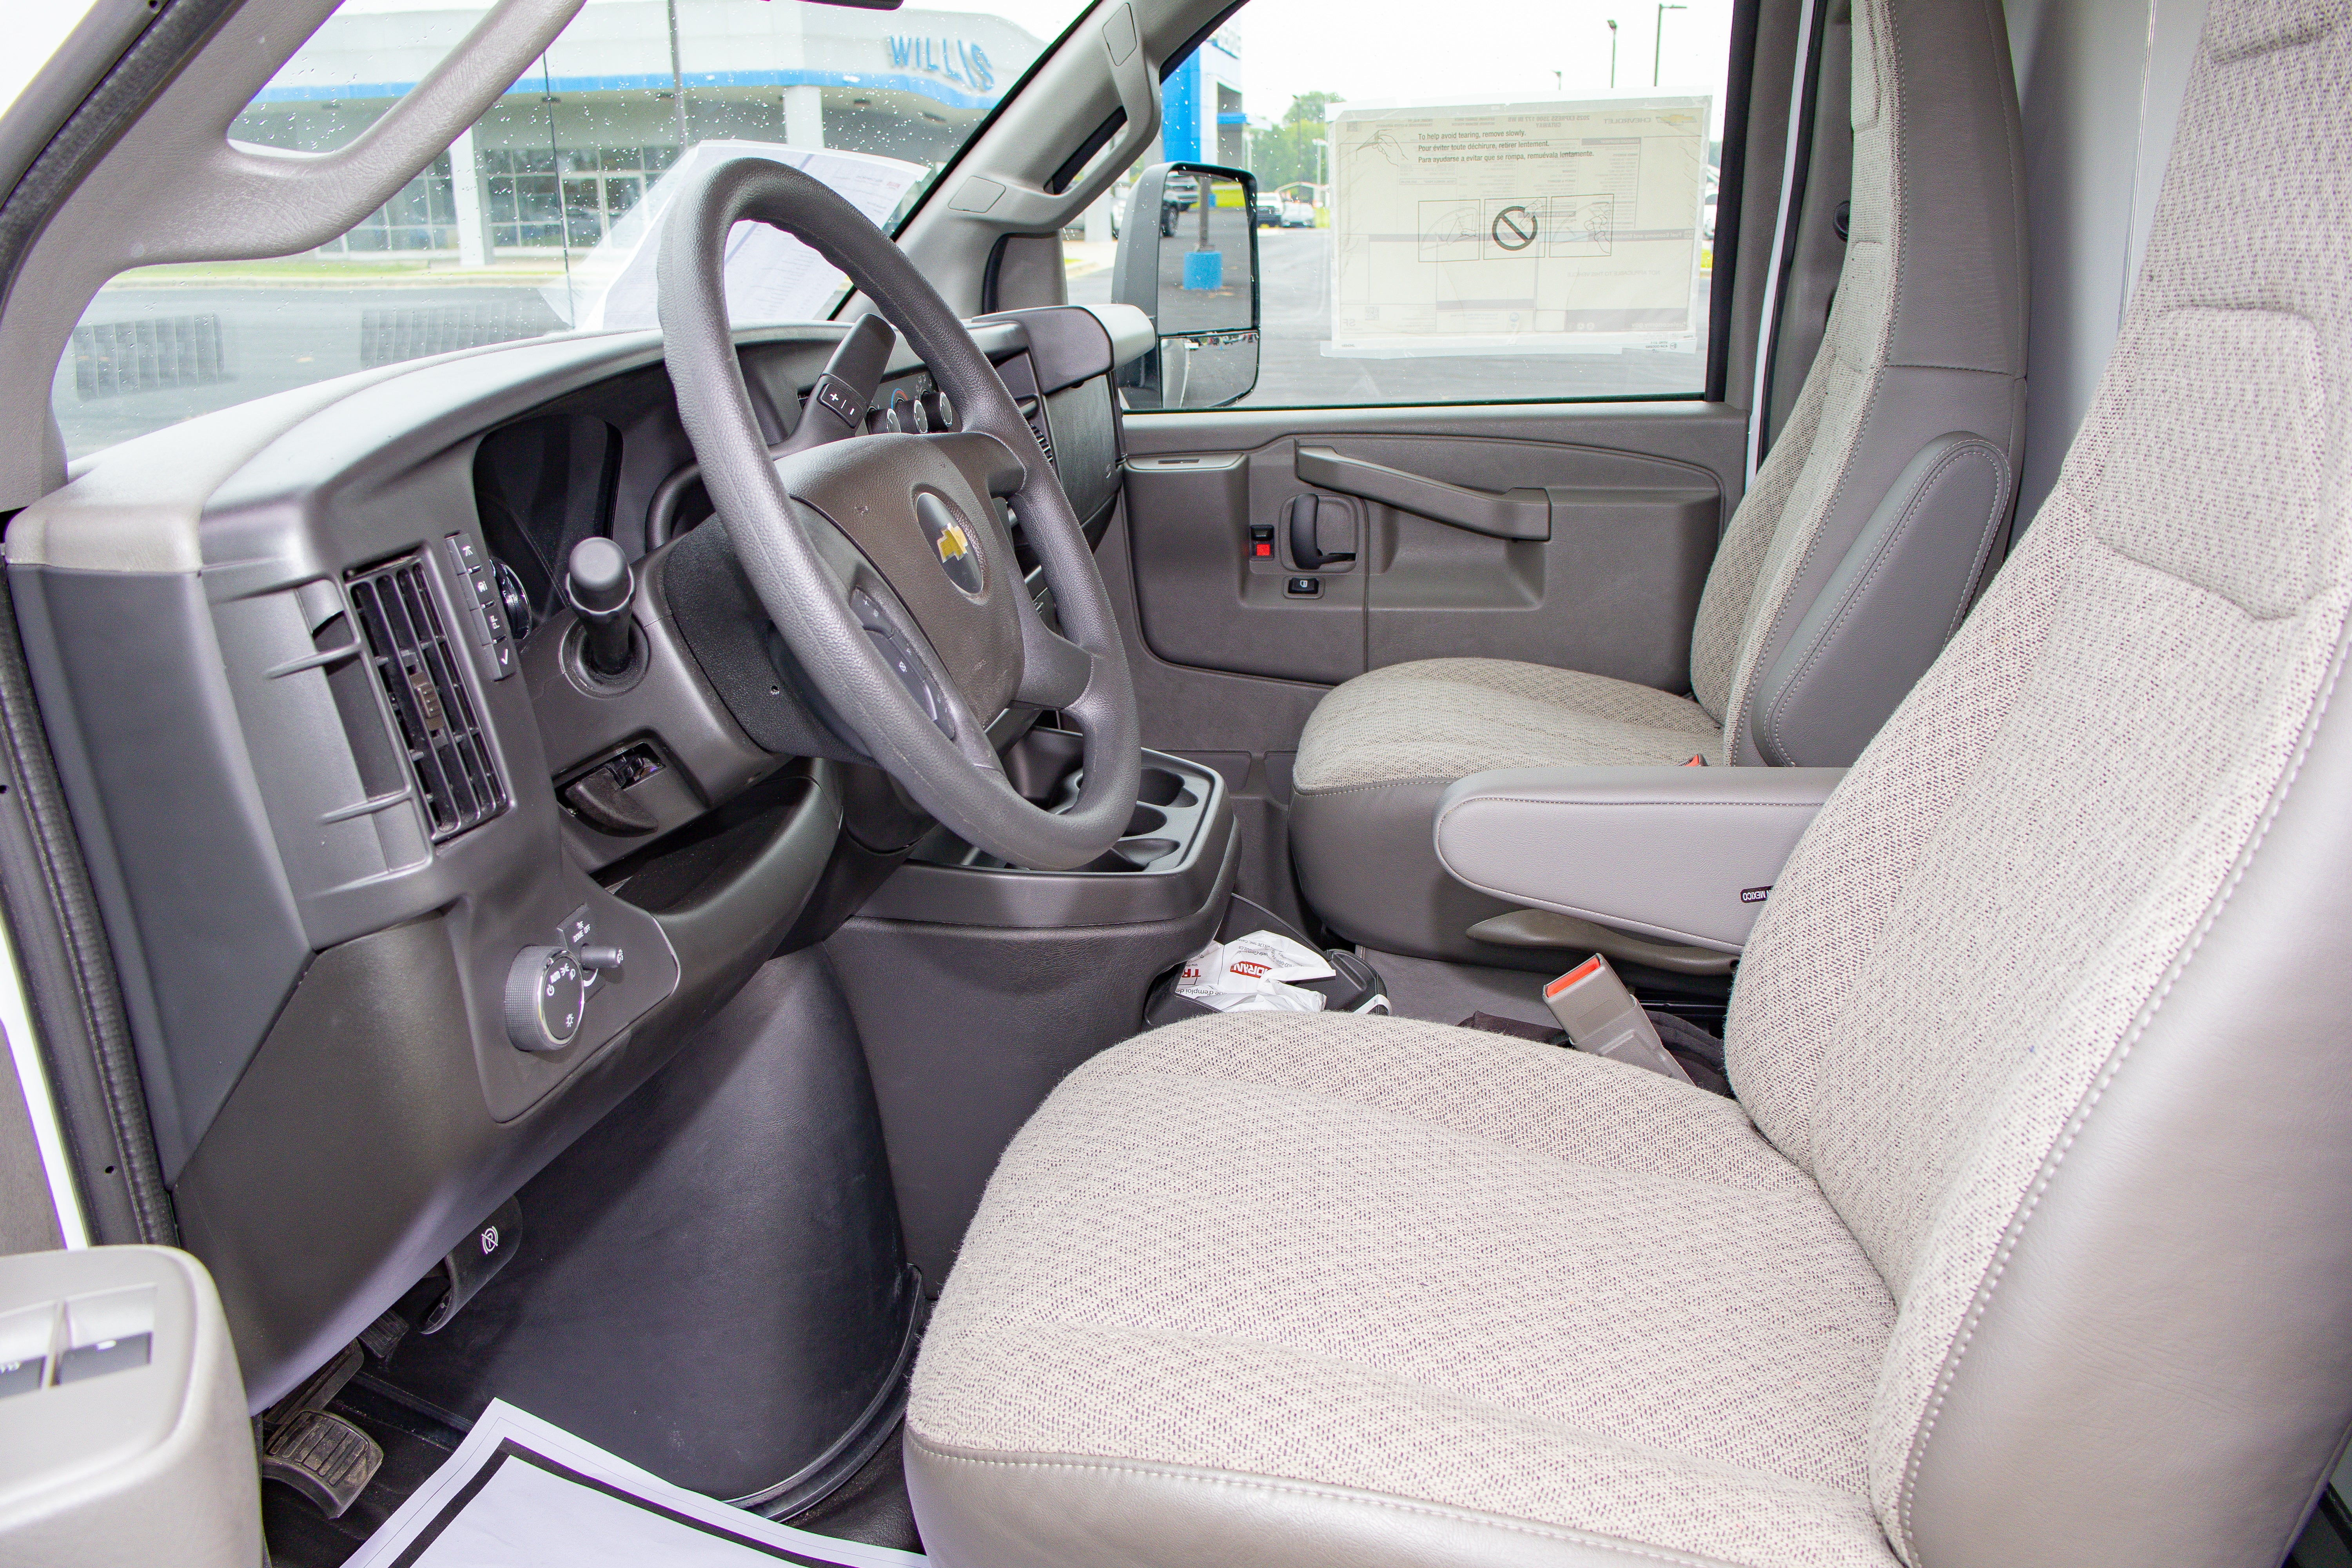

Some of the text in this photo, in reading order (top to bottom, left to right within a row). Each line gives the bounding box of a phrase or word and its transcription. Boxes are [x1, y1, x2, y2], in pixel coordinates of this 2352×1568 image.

[890, 34, 995, 91] WILLS
[1742, 890, 1765, 901] MEXICO
[573, 930, 584, 942] DOME
[550, 970, 561, 984] AUTO
